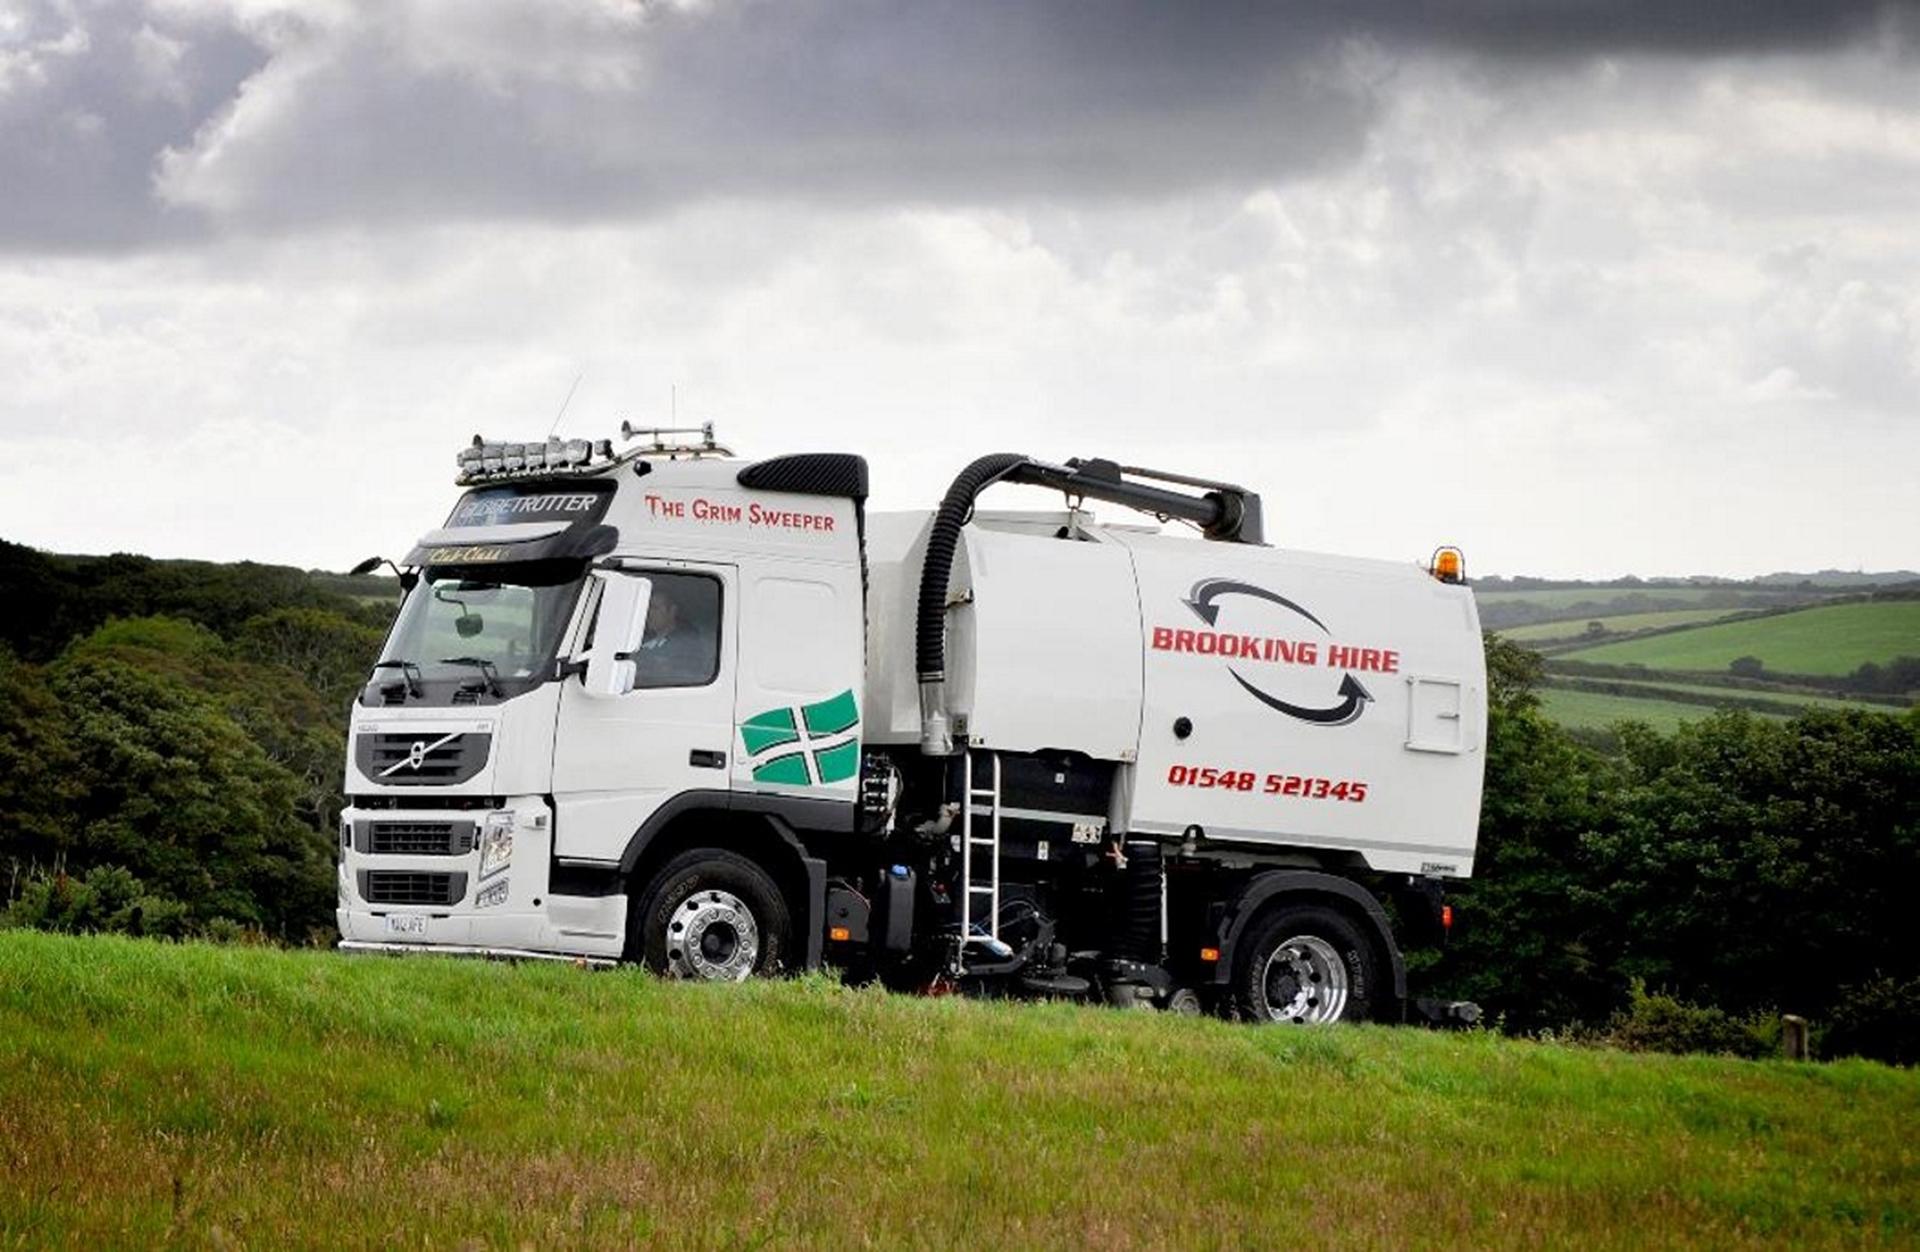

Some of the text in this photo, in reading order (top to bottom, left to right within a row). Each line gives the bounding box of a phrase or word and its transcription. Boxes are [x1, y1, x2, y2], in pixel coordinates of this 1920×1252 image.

[1152, 627, 1400, 673] BROOKING HIRE
[1168, 765, 1369, 803] 01548 521345
